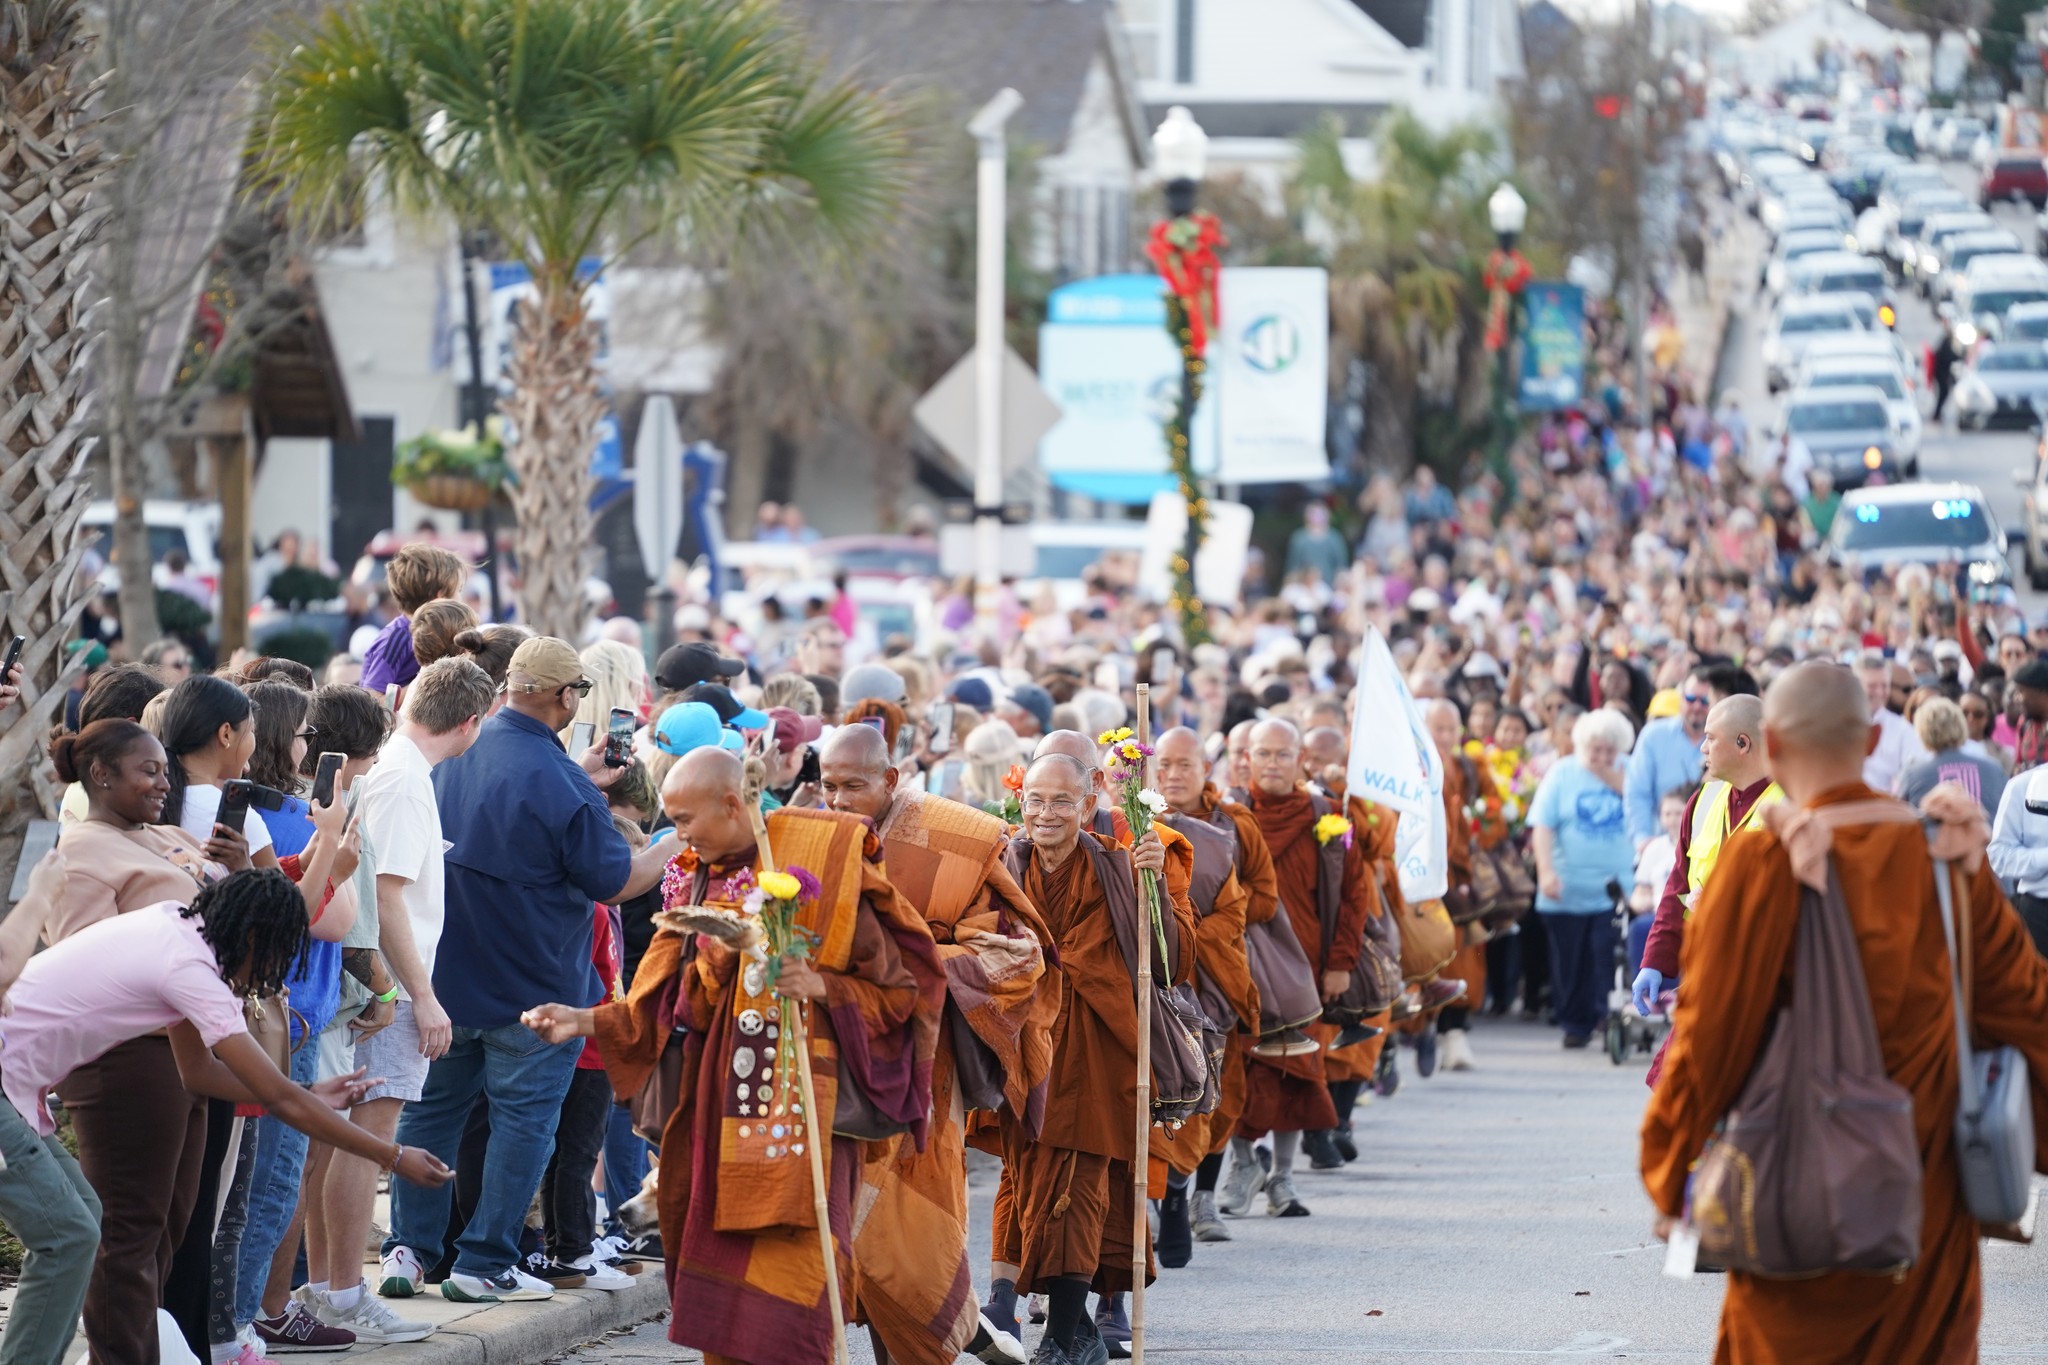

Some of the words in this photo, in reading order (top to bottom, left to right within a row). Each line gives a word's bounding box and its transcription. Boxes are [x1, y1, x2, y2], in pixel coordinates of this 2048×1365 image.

[1364, 767, 1424, 803] WALK
[630, 1237, 649, 1252] N
[286, 1319, 315, 1342] N
